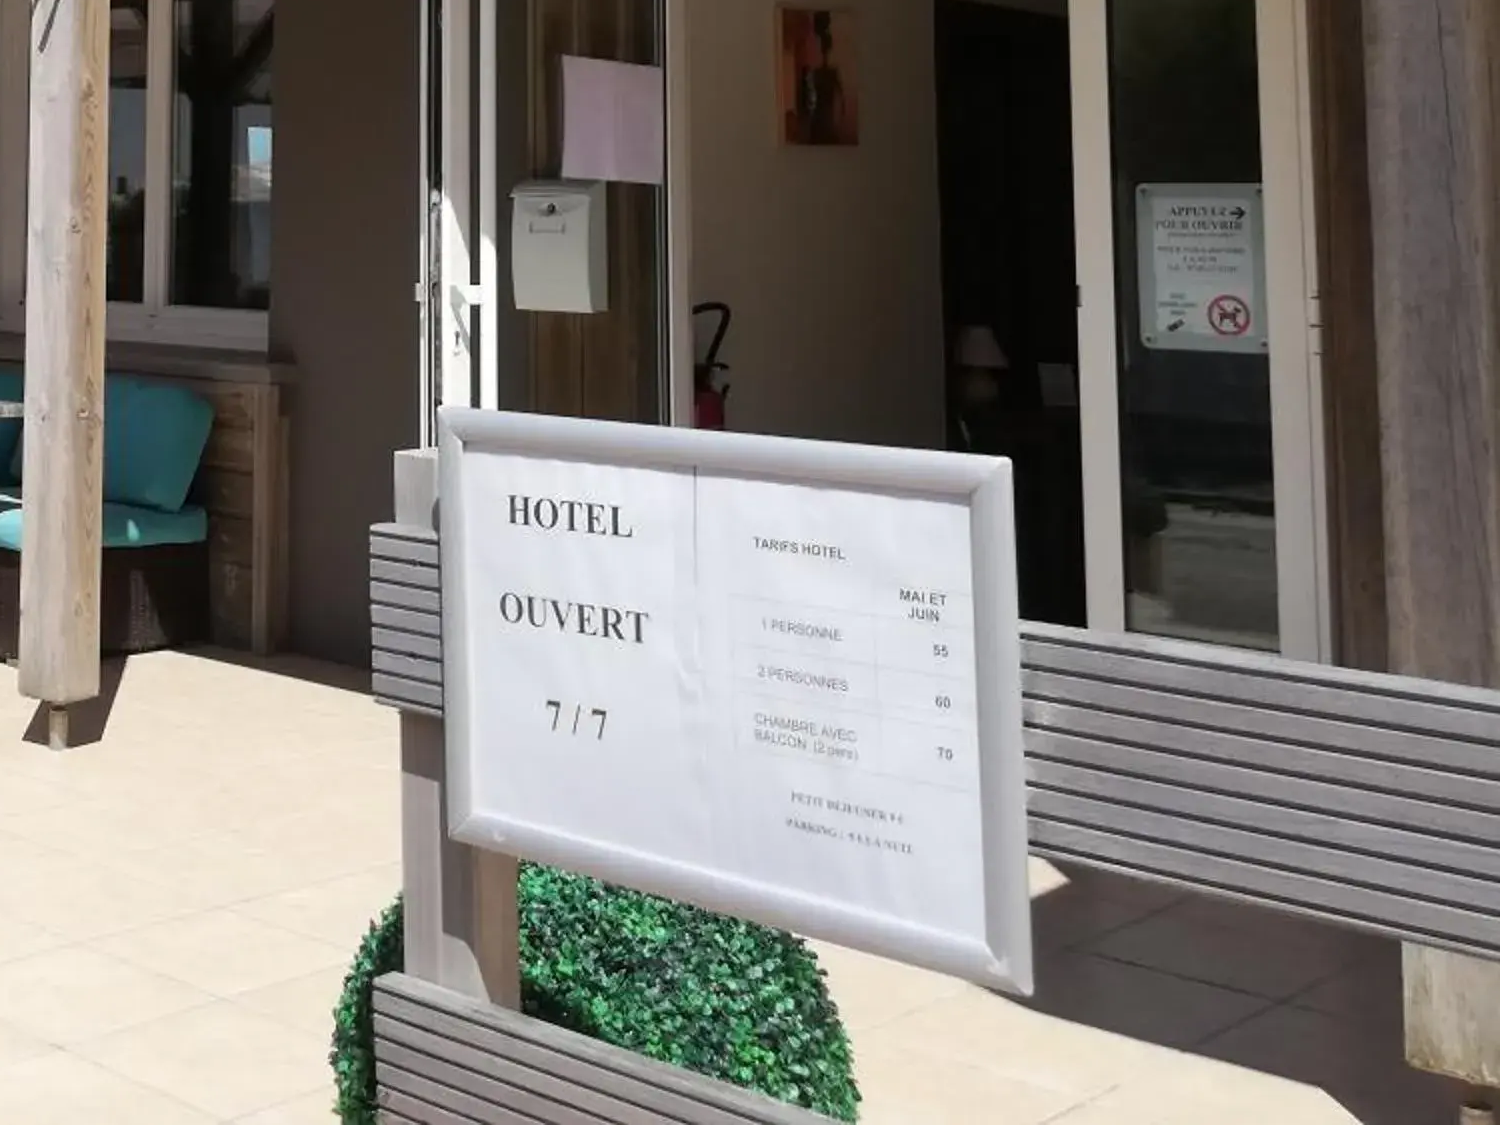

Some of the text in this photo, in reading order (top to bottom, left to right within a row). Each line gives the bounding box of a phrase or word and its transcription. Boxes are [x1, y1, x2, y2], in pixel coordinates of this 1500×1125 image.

[508, 494, 633, 538] HOTEL
[753, 536, 847, 561] TARIFS HOTEL
[899, 588, 947, 606] MAI ET
[499, 591, 650, 644] OUVERT
[907, 606, 940, 622] JUIN
[771, 619, 843, 642] PERSONNE
[933, 644, 949, 657] 55
[767, 667, 850, 693] PERSONNES
[754, 712, 858, 743] CHAMBRE AVEC
[753, 728, 807, 751] BALCON
[938, 746, 954, 761] 70
